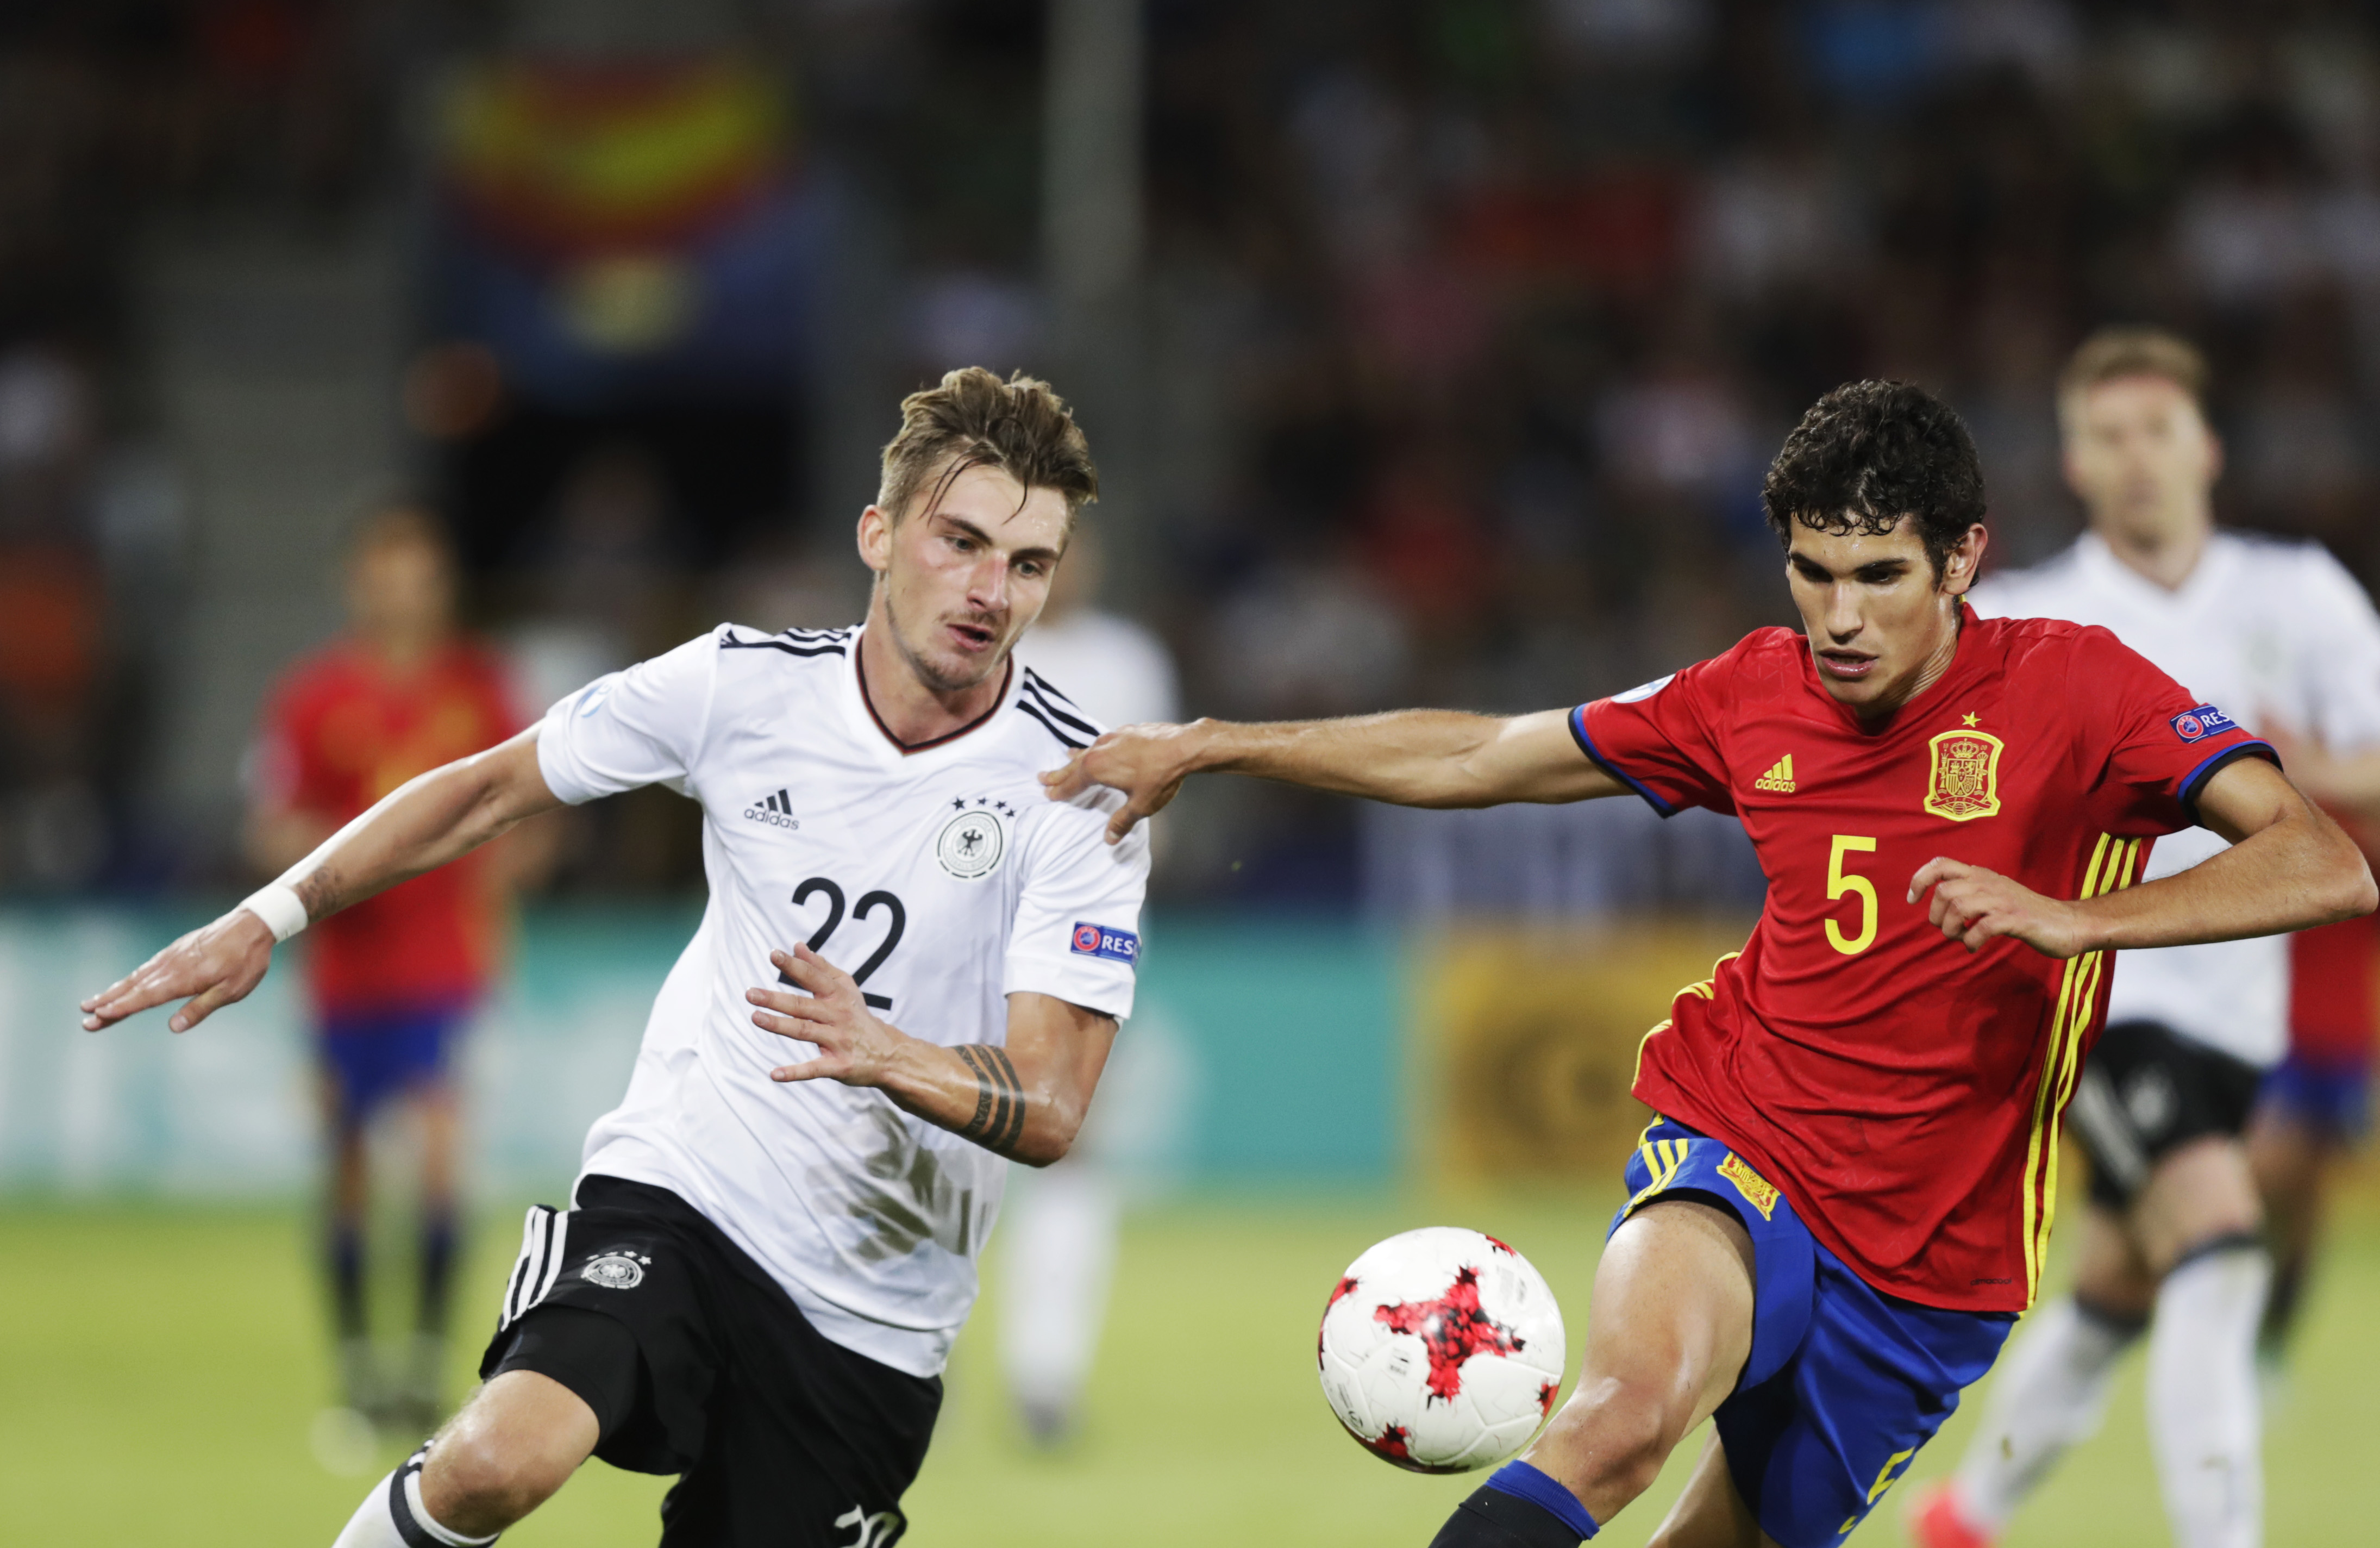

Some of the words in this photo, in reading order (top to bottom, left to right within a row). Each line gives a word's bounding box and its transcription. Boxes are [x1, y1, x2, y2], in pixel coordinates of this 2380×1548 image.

[1755, 777, 1796, 793] adidas
[744, 808, 799, 830] adidas
[1825, 834, 1878, 955] 5
[778, 877, 906, 1011] 22
[1101, 934, 1138, 959] RES
